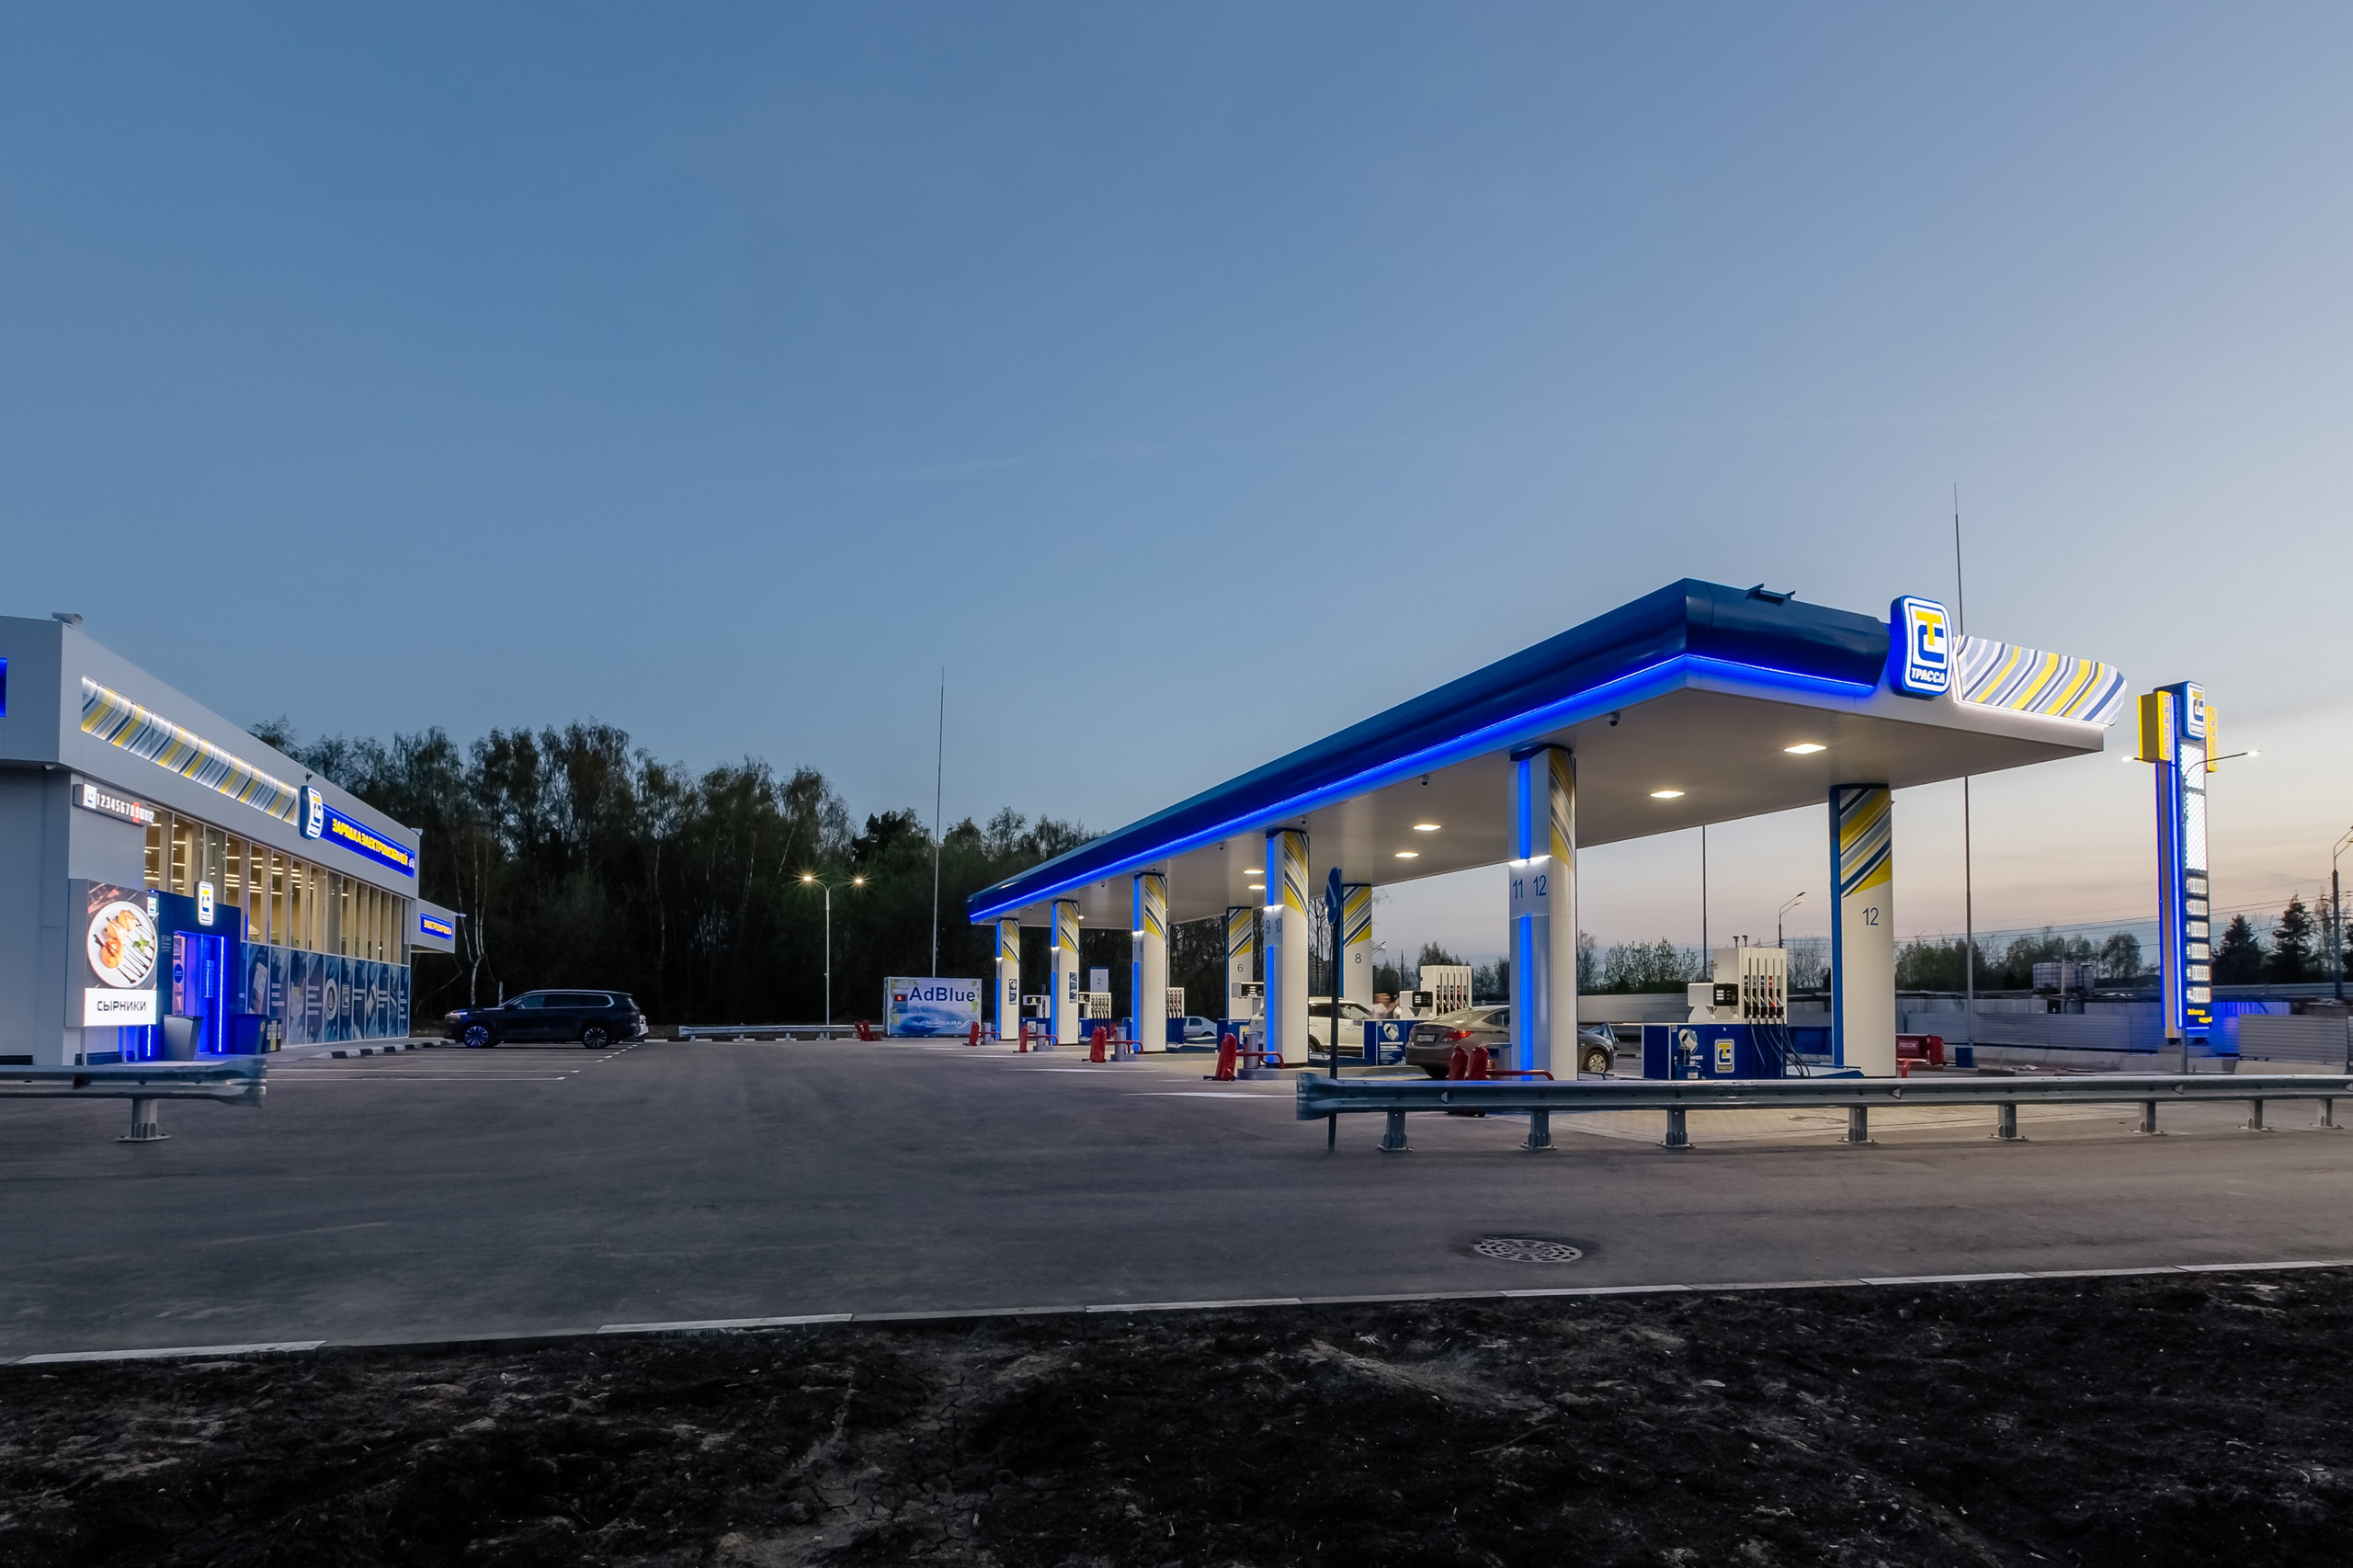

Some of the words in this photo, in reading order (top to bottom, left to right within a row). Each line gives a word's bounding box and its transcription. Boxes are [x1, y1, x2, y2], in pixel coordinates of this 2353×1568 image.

[1911, 667, 1946, 684] ТРАССА
[1512, 878, 1523, 900] 11
[1532, 874, 1547, 897] 12
[1862, 907, 1879, 926] 12
[1265, 921, 1271, 934] 9
[1275, 918, 1282, 933] 10
[1354, 953, 1362, 964] 8
[1237, 963, 1244, 972] 6
[909, 987, 976, 1002] AdBlue
[97, 1000, 147, 1012] СЫРНИКИ
